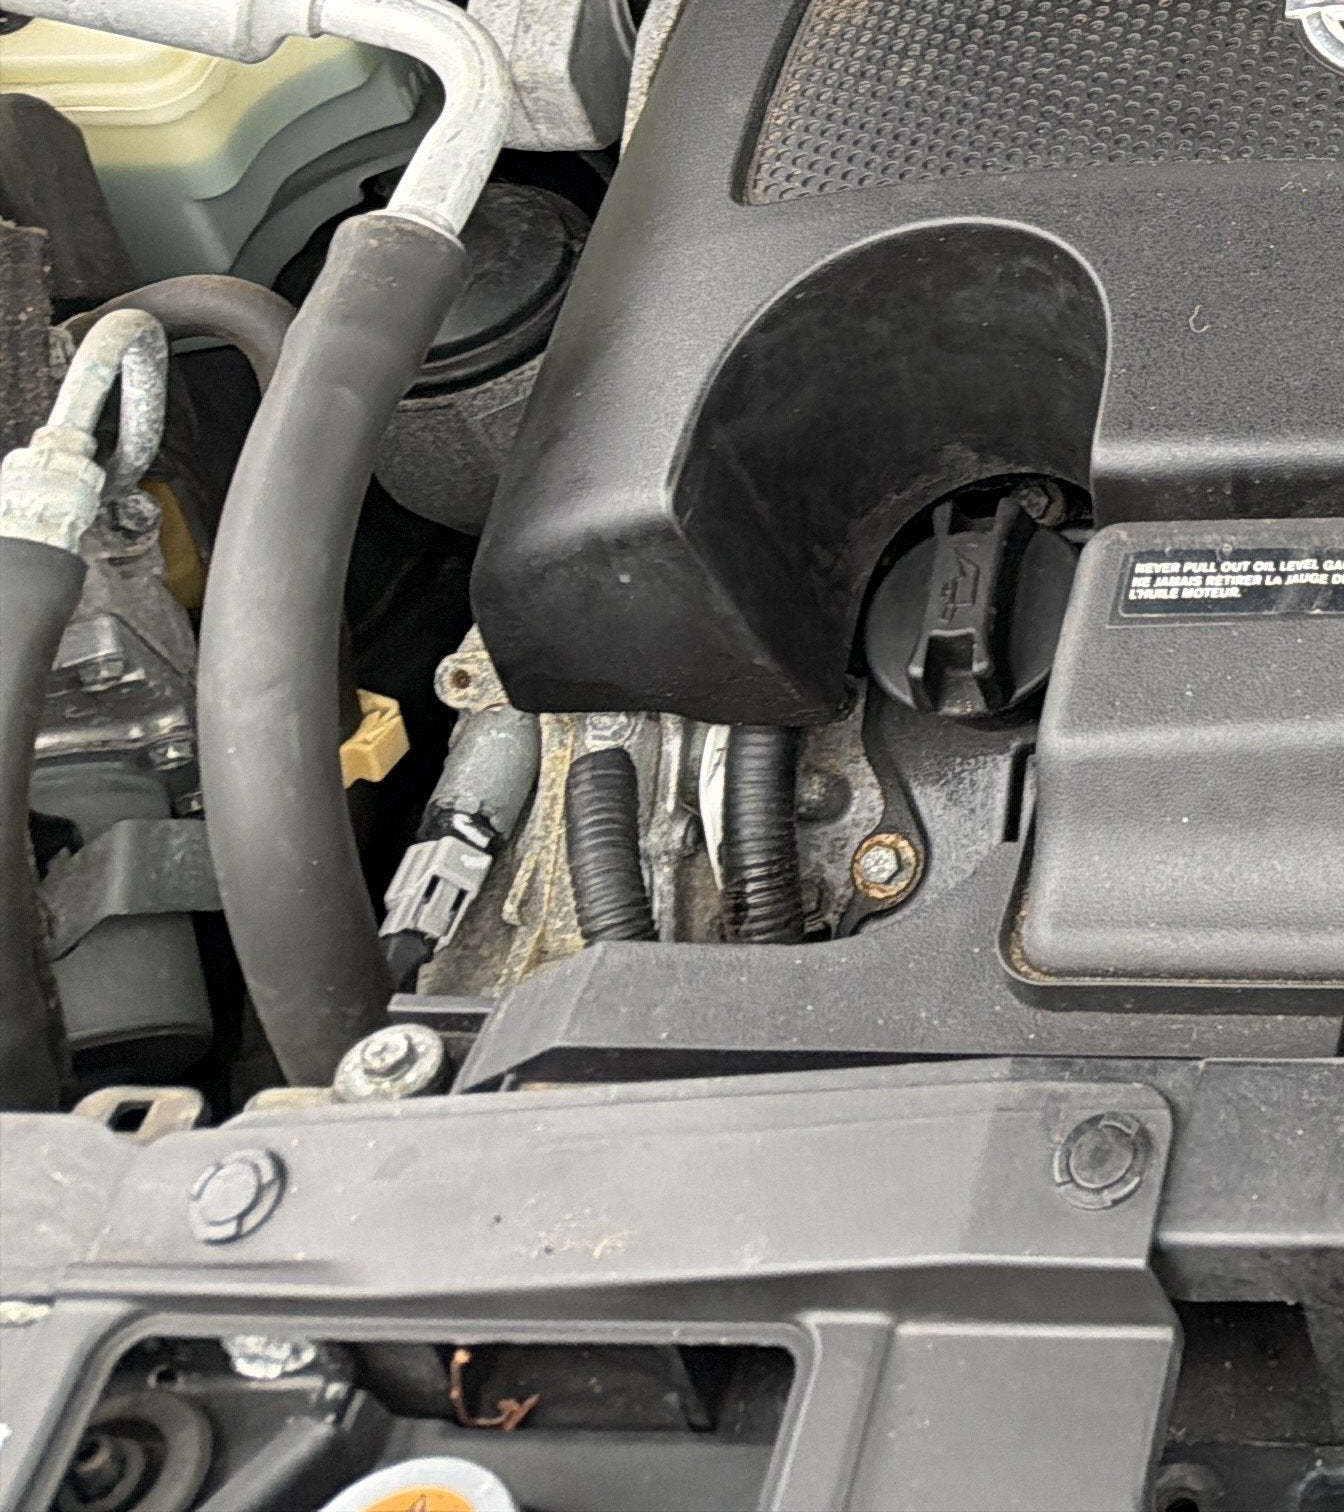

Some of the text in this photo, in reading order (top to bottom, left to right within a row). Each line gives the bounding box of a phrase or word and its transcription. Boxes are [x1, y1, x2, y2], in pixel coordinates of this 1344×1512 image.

[1134, 561, 1181, 574] NEVER
[1182, 561, 1217, 573] PULL
[1220, 560, 1251, 573] OUT
[1252, 560, 1276, 572] OIL
[1279, 558, 1319, 572] LEVEL
[1131, 576, 1151, 587] NE
[1153, 575, 1203, 587] JAMAIS
[1264, 574, 1282, 585] LA
[1285, 573, 1329, 585] JAUGE
[1181, 587, 1242, 599] MOTEUR.
